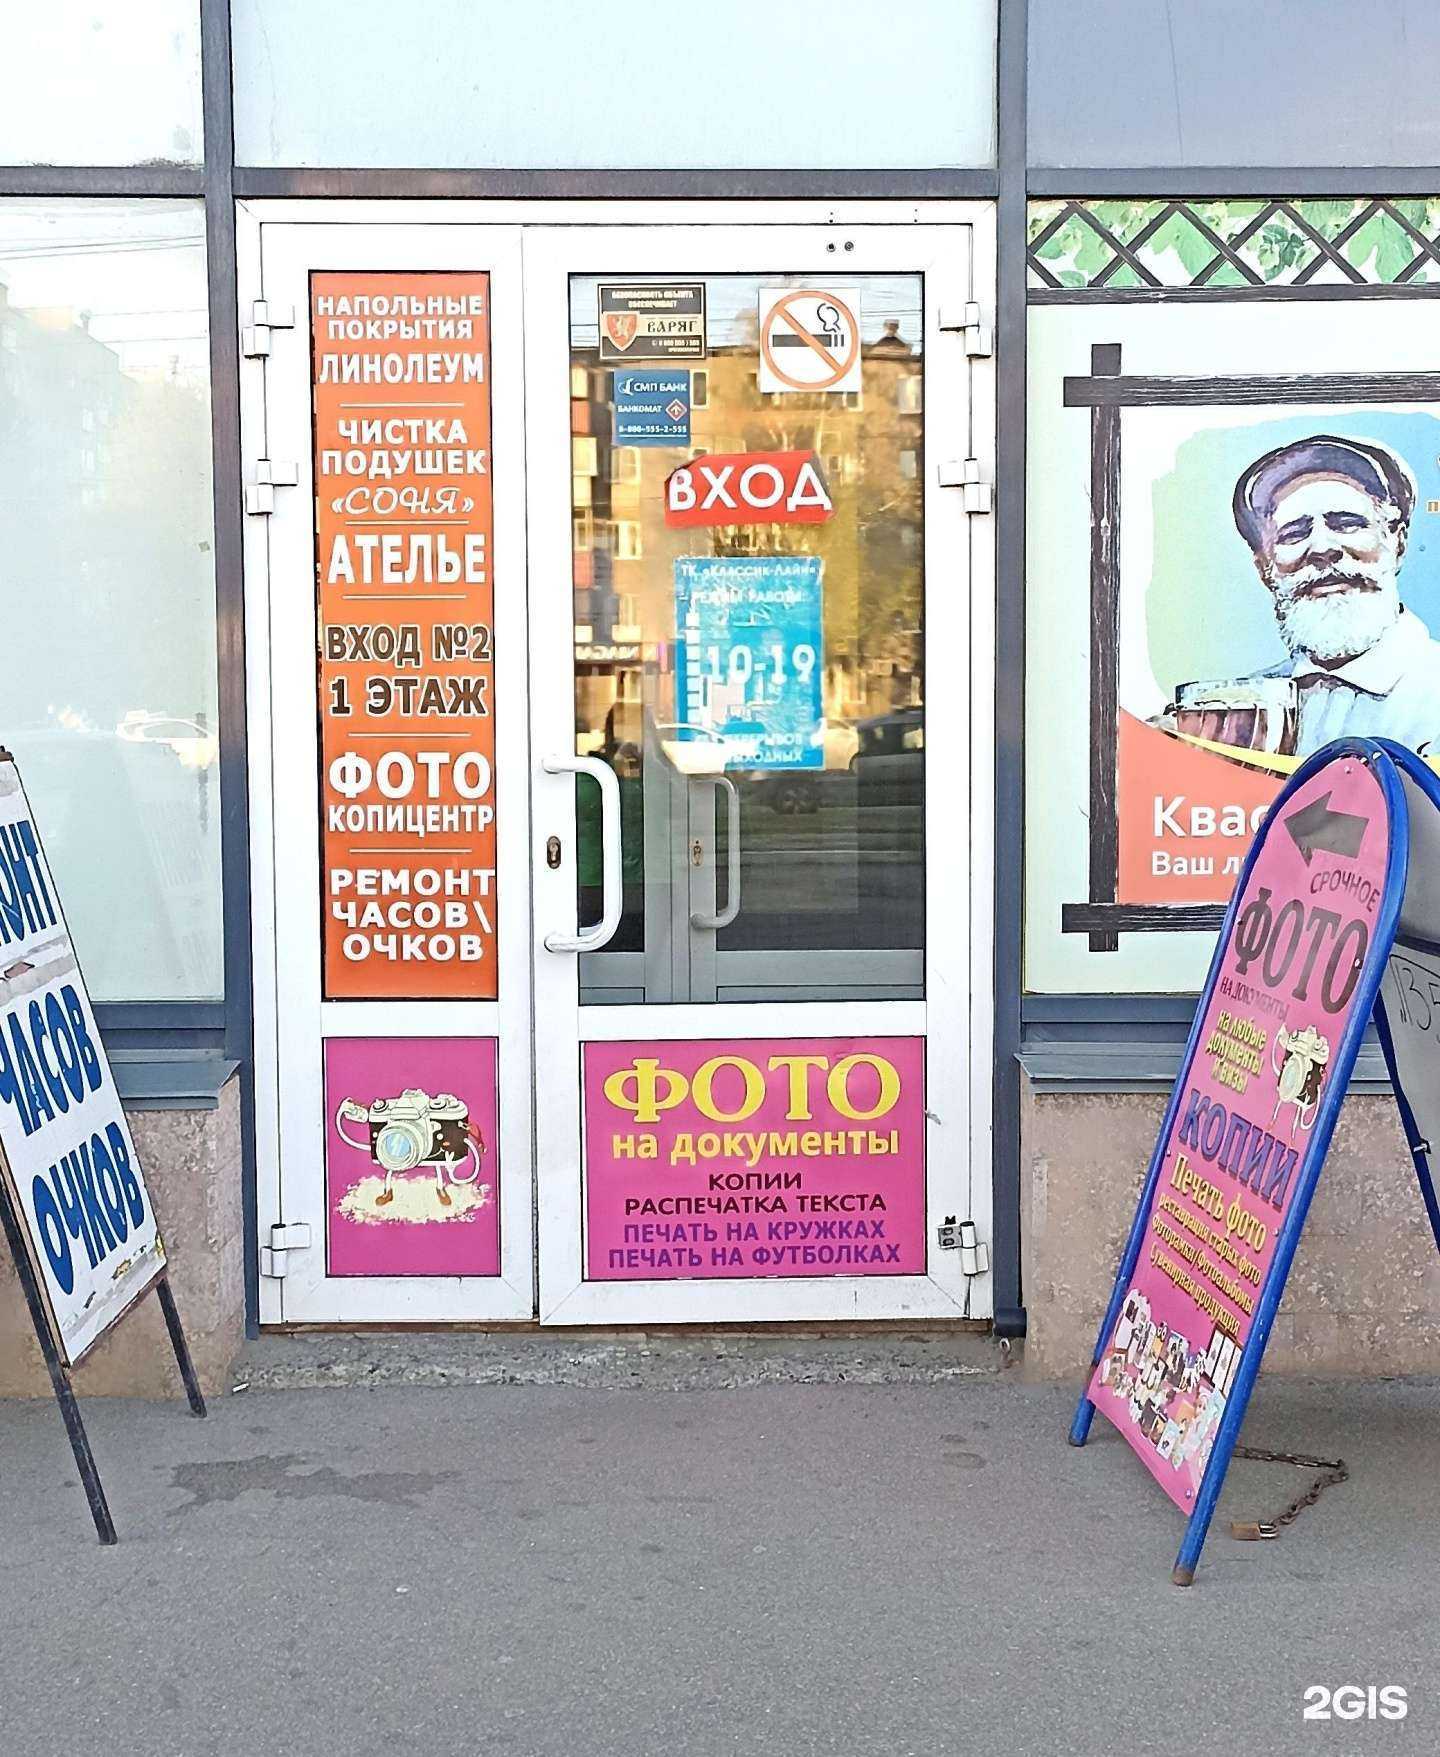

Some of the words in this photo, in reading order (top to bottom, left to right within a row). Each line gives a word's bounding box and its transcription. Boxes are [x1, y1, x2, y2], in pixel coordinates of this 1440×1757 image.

[317, 295, 483, 316] НАПОЛЬНЫЕ
[327, 319, 473, 340] ПОКРЫТИЯ
[319, 353, 485, 384] ЛИНОЛЕУМ
[633, 382, 658, 392] СМП
[659, 382, 688, 392] БАНК
[617, 405, 662, 413] БАНКОМАТ
[337, 419, 468, 445] ЧИСТКА
[321, 449, 487, 480] ПОДУШЕК
[669, 463, 833, 512] ВХОД
[327, 533, 486, 584] АТЕЛЬЕ
[326, 624, 423, 668] ВХОД
[432, 624, 492, 662] №2
[706, 644, 816, 684] 10-19
[330, 676, 352, 717] 1
[366, 676, 489, 718] ЭТАЖ
[329, 751, 491, 799] ФОТО
[328, 804, 494, 838] КОПИЦЕНТР
[1151, 850, 1214, 876] Ваш
[330, 868, 495, 896] РЕМОНТ
[1310, 869, 1380, 912] СРОЧНОЕ
[342, 933, 484, 961] ОЧКОВ
[1234, 887, 1369, 1014] ФОТО
[603, 1053, 901, 1123] ФОТО
[612, 1133, 658, 1160] на
[670, 1129, 899, 1167] документы
[1178, 1088, 1299, 1212] КОПИИ
[708, 1172, 802, 1191] КОПИИ
[32, 1121, 145, 1295] ОЧКОВ
[625, 1195, 787, 1216] РАСПЕЧАТКА
[796, 1194, 887, 1213] ТЕКСТА
[1169, 1151, 1225, 1222] Печать
[1225, 1193, 1268, 1254] фото
[624, 1222, 718, 1244] ПЕЧАТЬ
[726, 1221, 759, 1242] НА
[768, 1219, 886, 1240] КРУЖКАХ
[608, 1247, 703, 1268] ПЕЧАТЬ
[711, 1246, 744, 1267] НА
[752, 1243, 901, 1266] ФУТБОЛКАХ
[1237, 1251, 1262, 1287] фото
